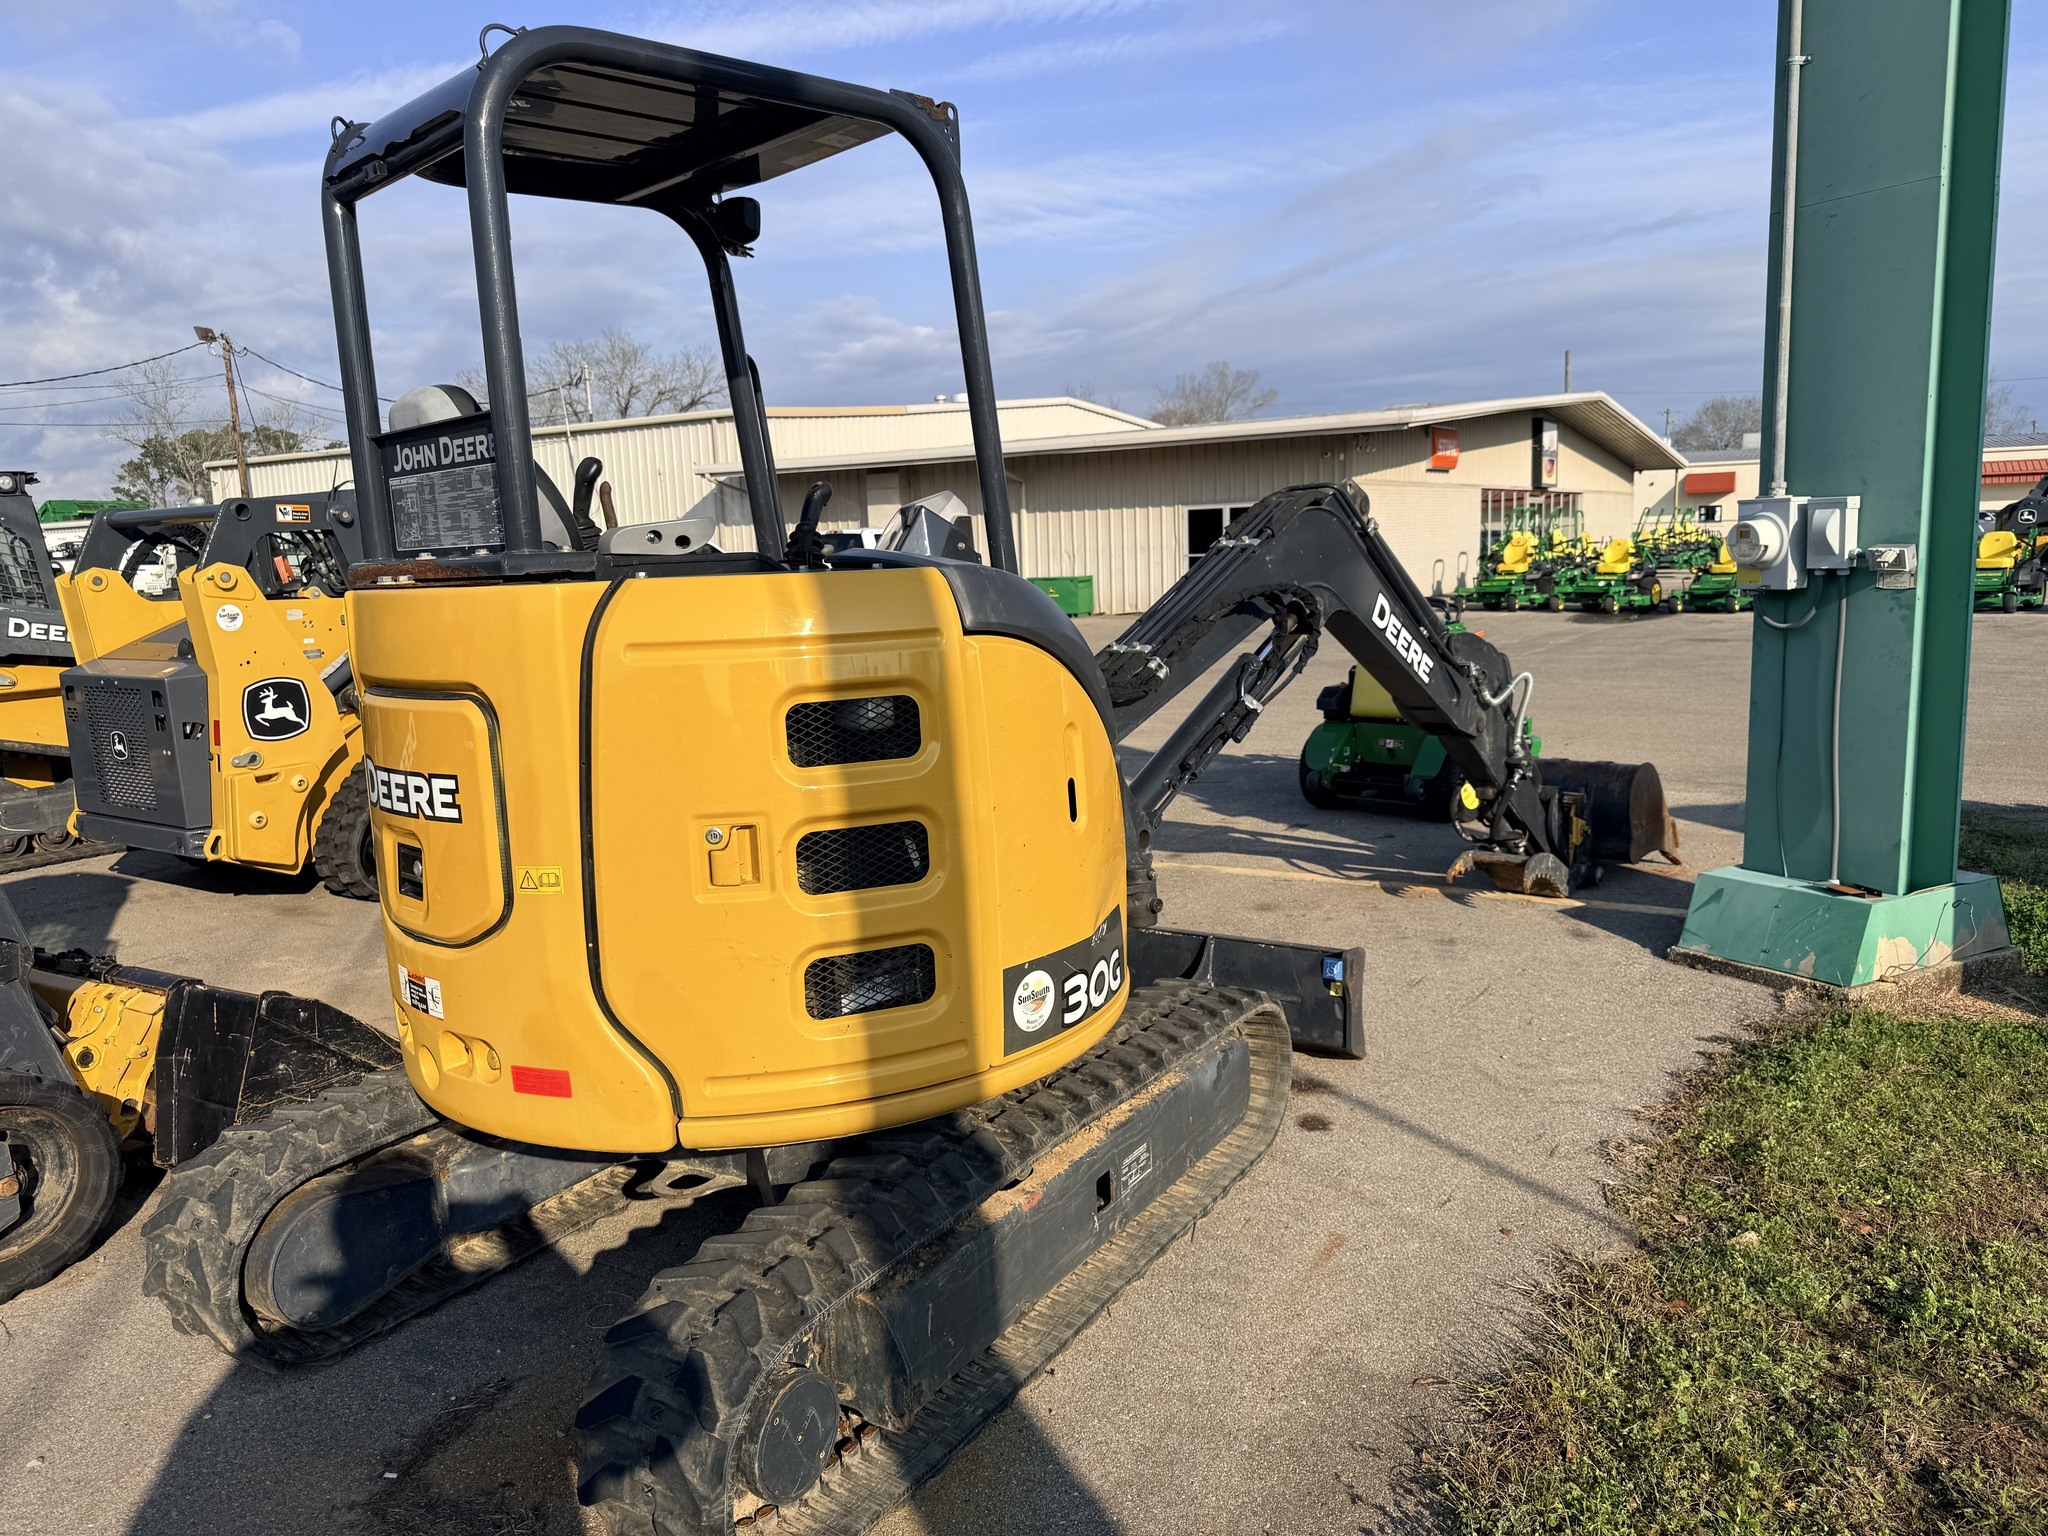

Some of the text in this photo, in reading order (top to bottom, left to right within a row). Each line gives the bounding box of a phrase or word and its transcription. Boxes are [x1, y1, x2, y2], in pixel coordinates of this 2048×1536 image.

[393, 443, 438, 473] JOHN
[7, 616, 71, 643] DEE
[1371, 592, 1435, 685] DEERE
[365, 756, 461, 820] DEERE
[1018, 985, 1050, 1005] SunSouth
[1063, 948, 1121, 1025] 30G
